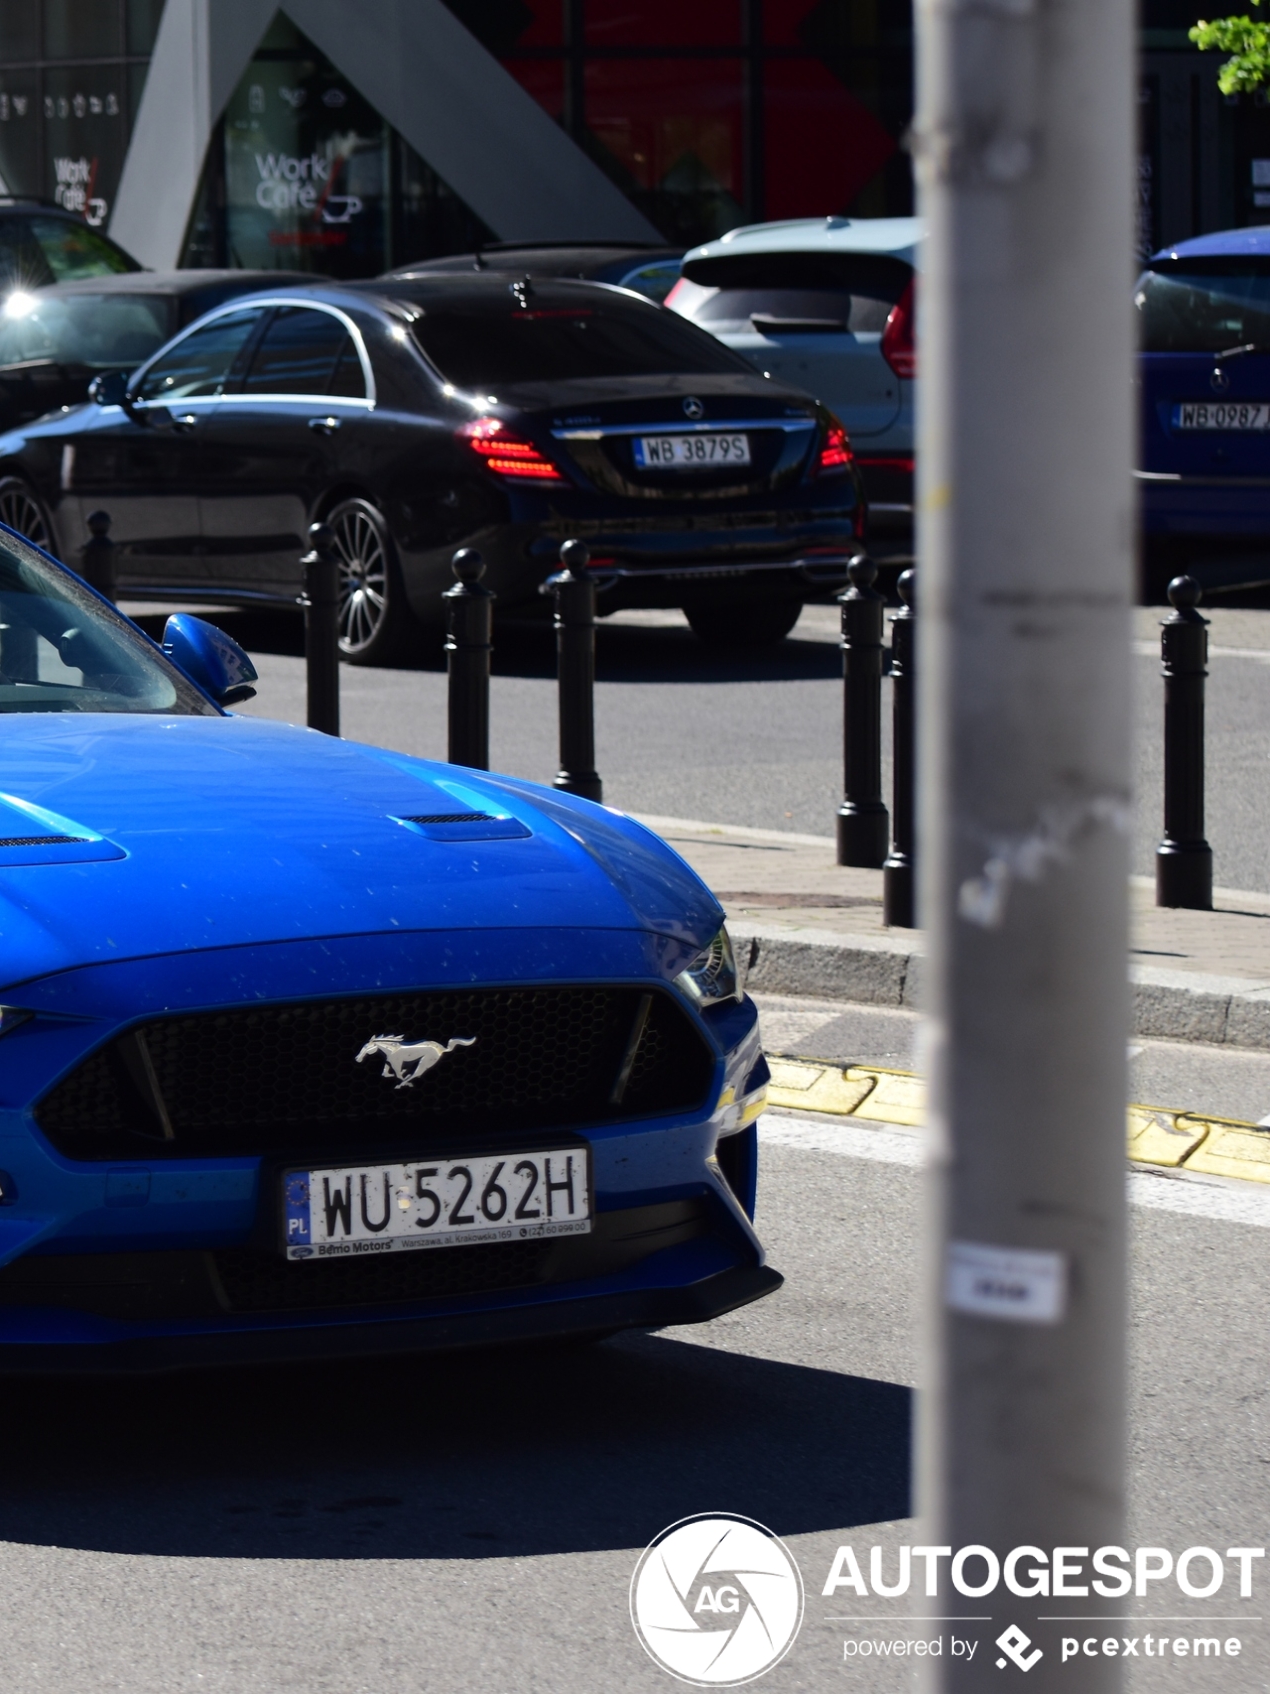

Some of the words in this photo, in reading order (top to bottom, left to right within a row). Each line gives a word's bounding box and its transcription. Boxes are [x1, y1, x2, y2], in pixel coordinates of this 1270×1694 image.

[54, 157, 91, 183] Work
[255, 152, 328, 180] Work
[255, 180, 317, 209] Café
[1182, 405, 1209, 428] WB
[647, 439, 674, 462] WB
[681, 437, 745, 460] 3879S
[322, 1170, 391, 1238] WU
[414, 1156, 575, 1229] 5262H
[288, 1218, 308, 1236] PL
[455, 1231, 497, 1243] Krakowska
[498, 1230, 512, 1239] 169
[318, 1244, 351, 1256] Bemo
[352, 1240, 392, 1253] Motors
